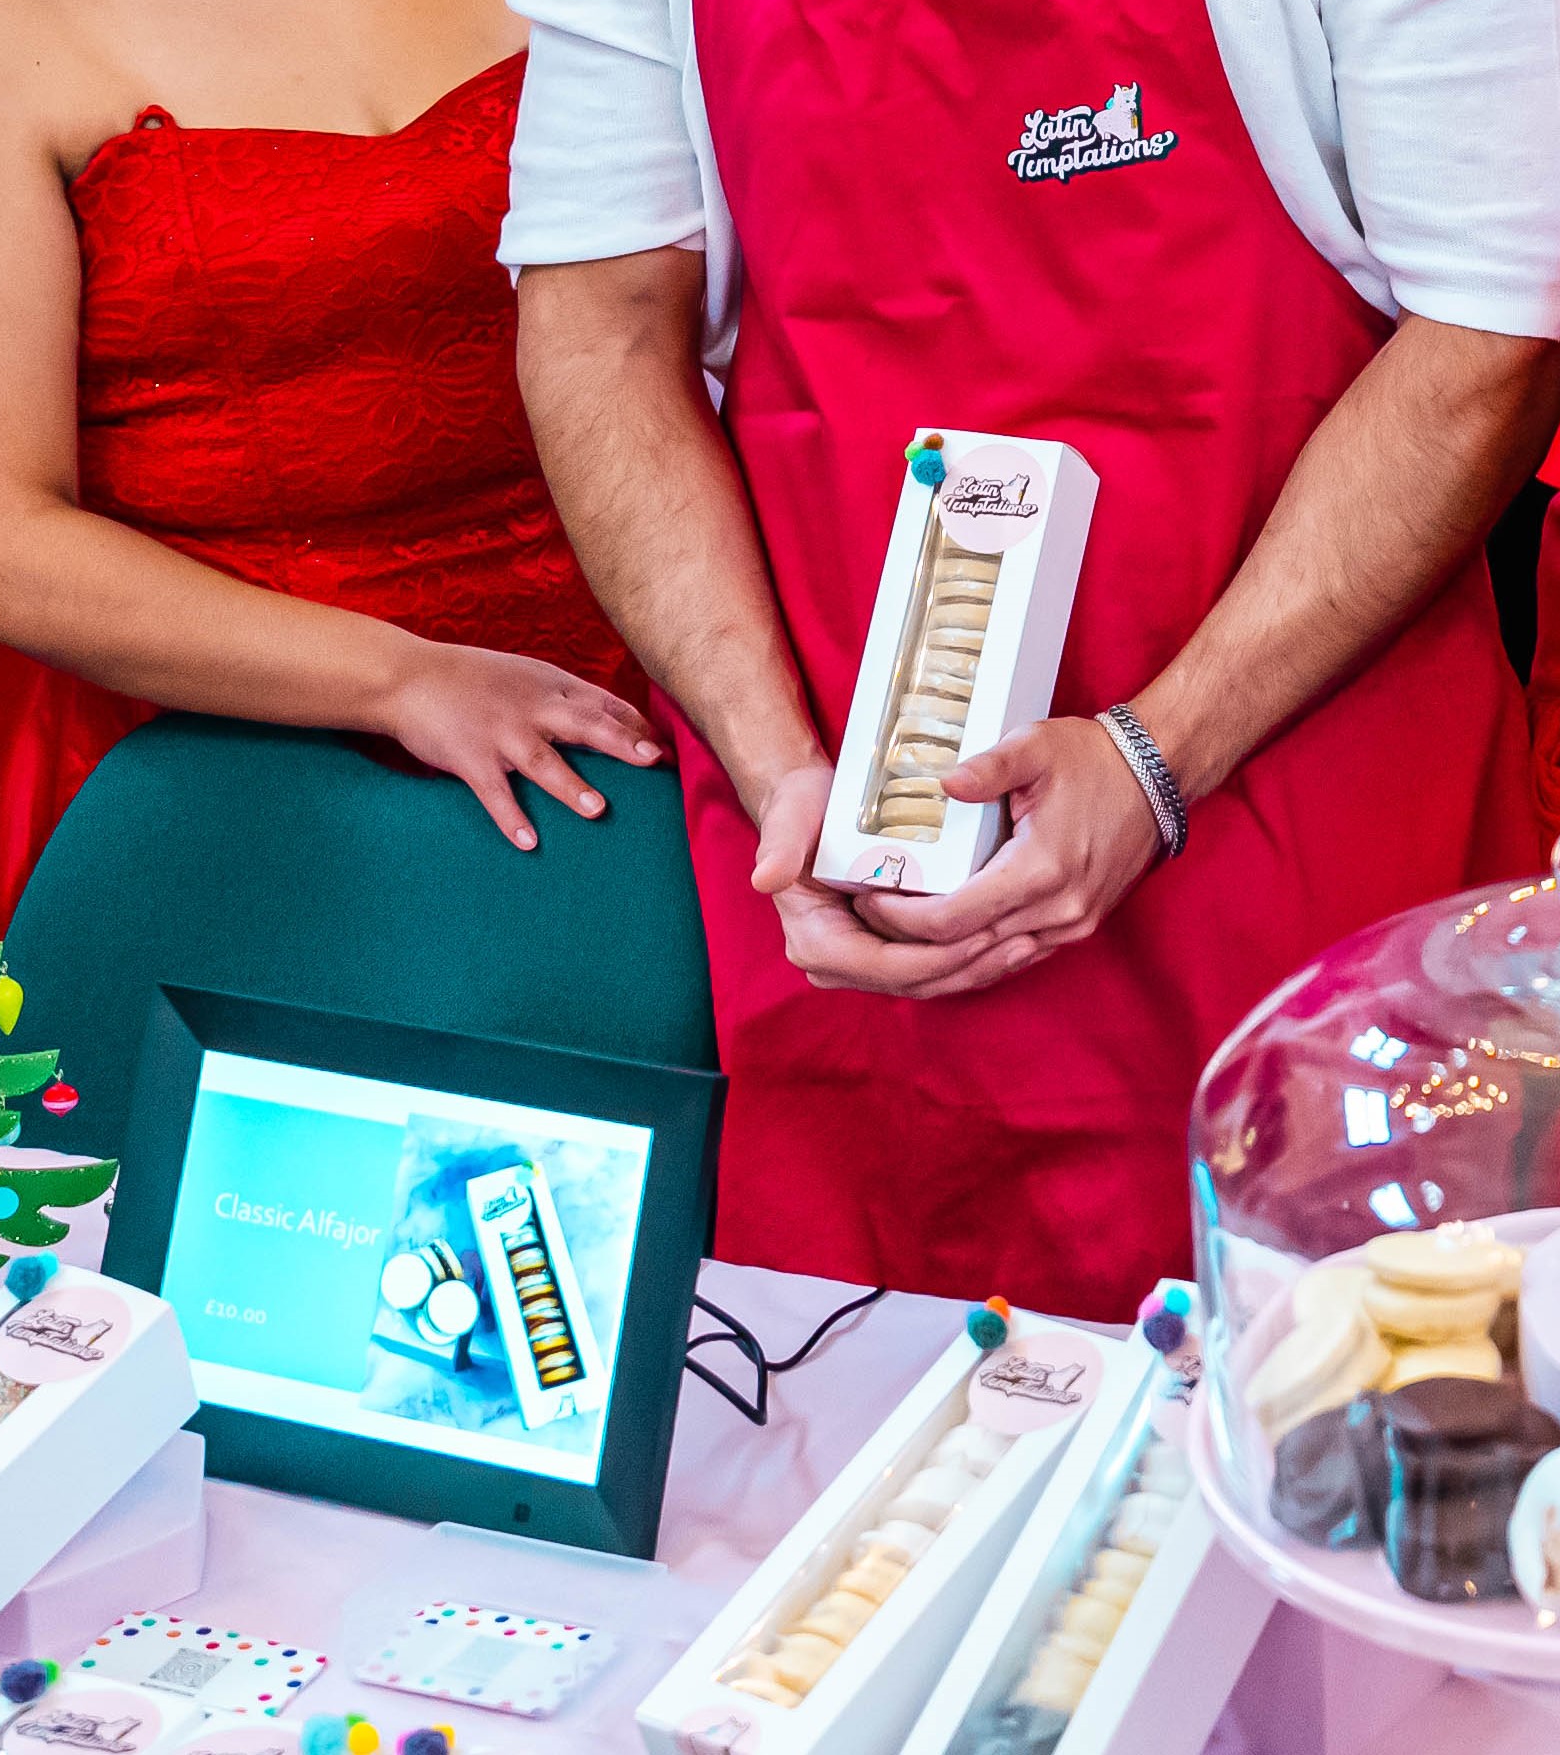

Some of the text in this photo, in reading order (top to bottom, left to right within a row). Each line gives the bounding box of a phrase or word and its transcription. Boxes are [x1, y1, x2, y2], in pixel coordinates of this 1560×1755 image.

[1020, 106, 1092, 149] Latin
[1007, 131, 1174, 179] Temptations
[954, 476, 1003, 498] Latin
[215, 1193, 381, 1249] Classic Alfajor
[205, 1299, 268, 1325] £10.00
